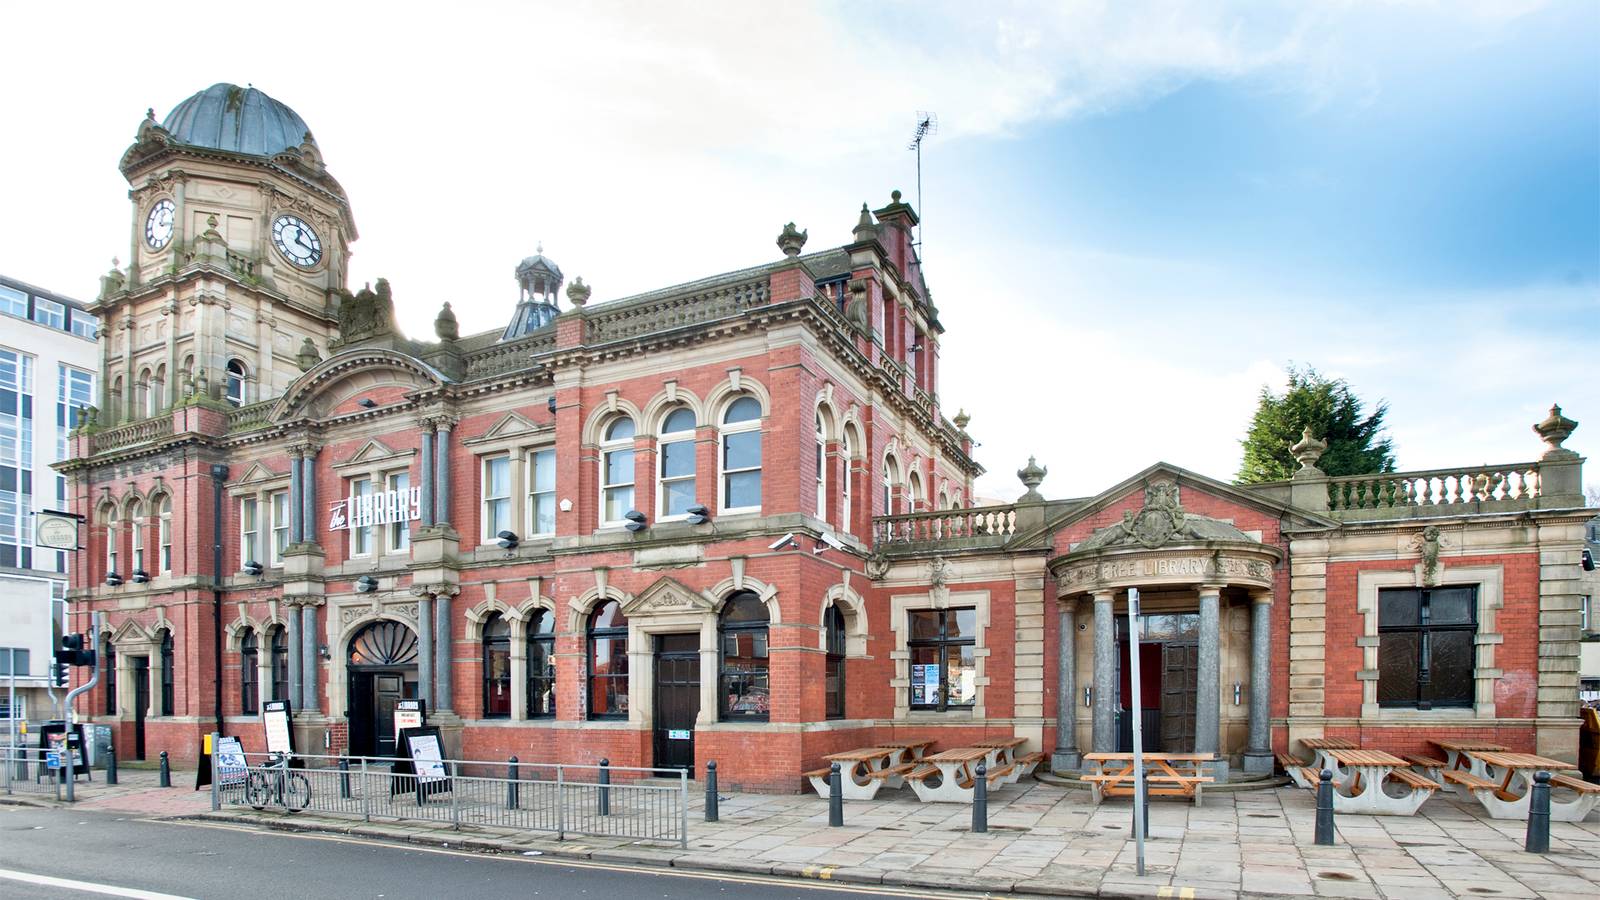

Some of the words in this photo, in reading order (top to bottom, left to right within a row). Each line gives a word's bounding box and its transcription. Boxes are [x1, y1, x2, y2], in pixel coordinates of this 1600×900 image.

[347, 486, 421, 528] LIBRARY
[1101, 564, 1137, 579] FREE
[1143, 559, 1209, 576] LIBRARY
